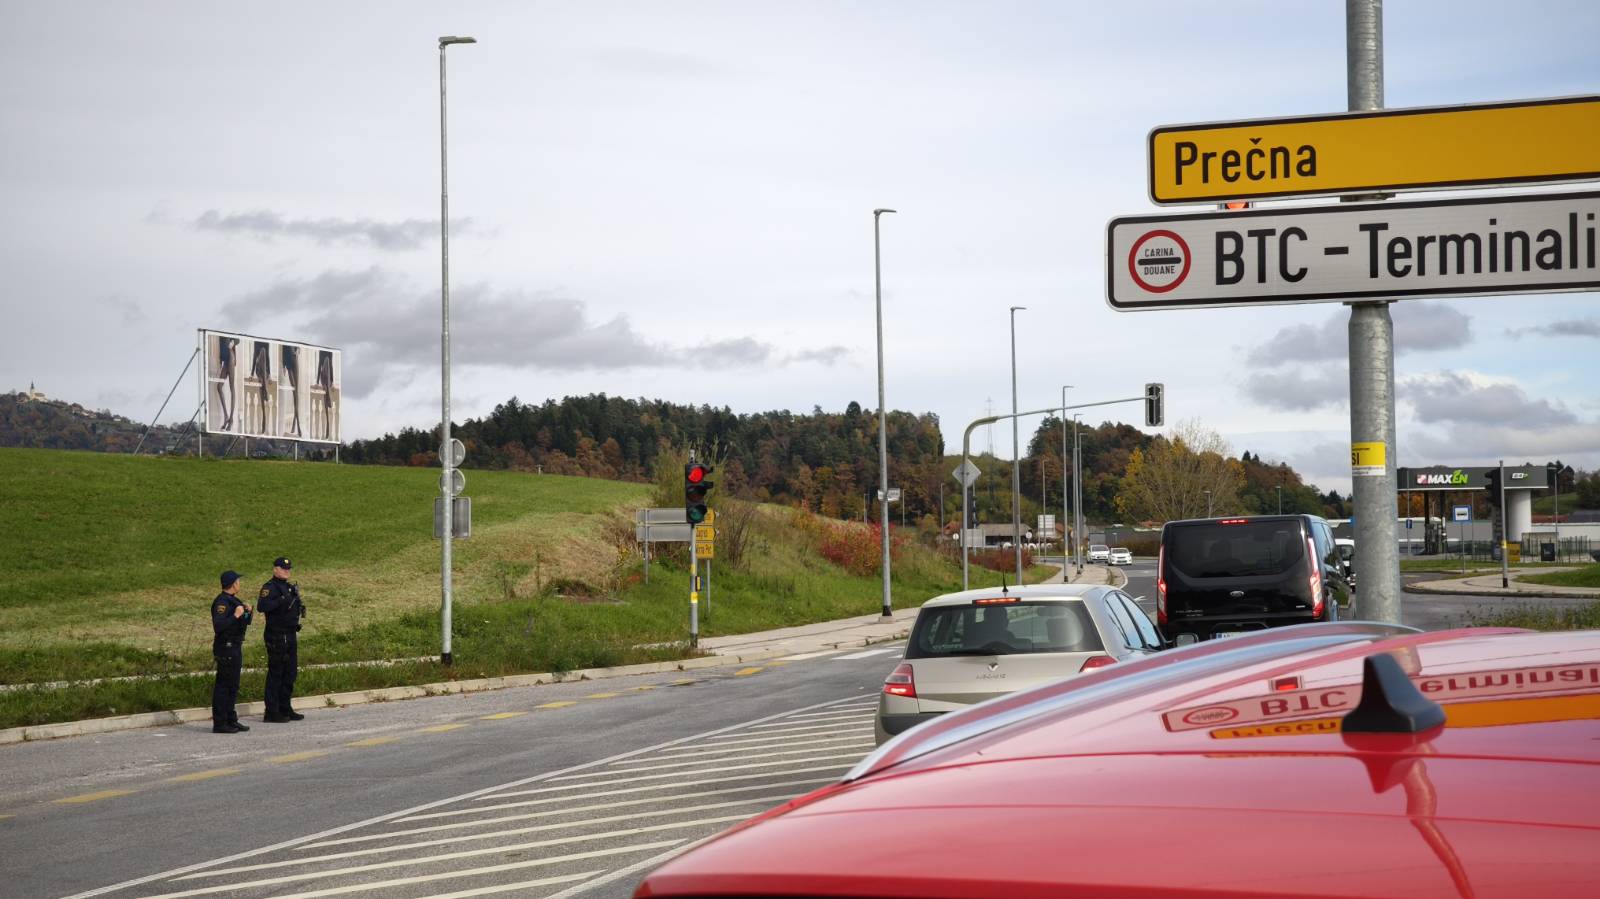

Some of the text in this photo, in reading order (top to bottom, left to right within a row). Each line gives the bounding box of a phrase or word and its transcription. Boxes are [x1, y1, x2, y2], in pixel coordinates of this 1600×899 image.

[1175, 138, 1317, 185] Prečna
[1144, 248, 1174, 257] CARINA
[1216, 227, 1308, 285] BTC
[1359, 212, 1596, 279] Terminali
[1144, 265, 1175, 275] DOUANE
